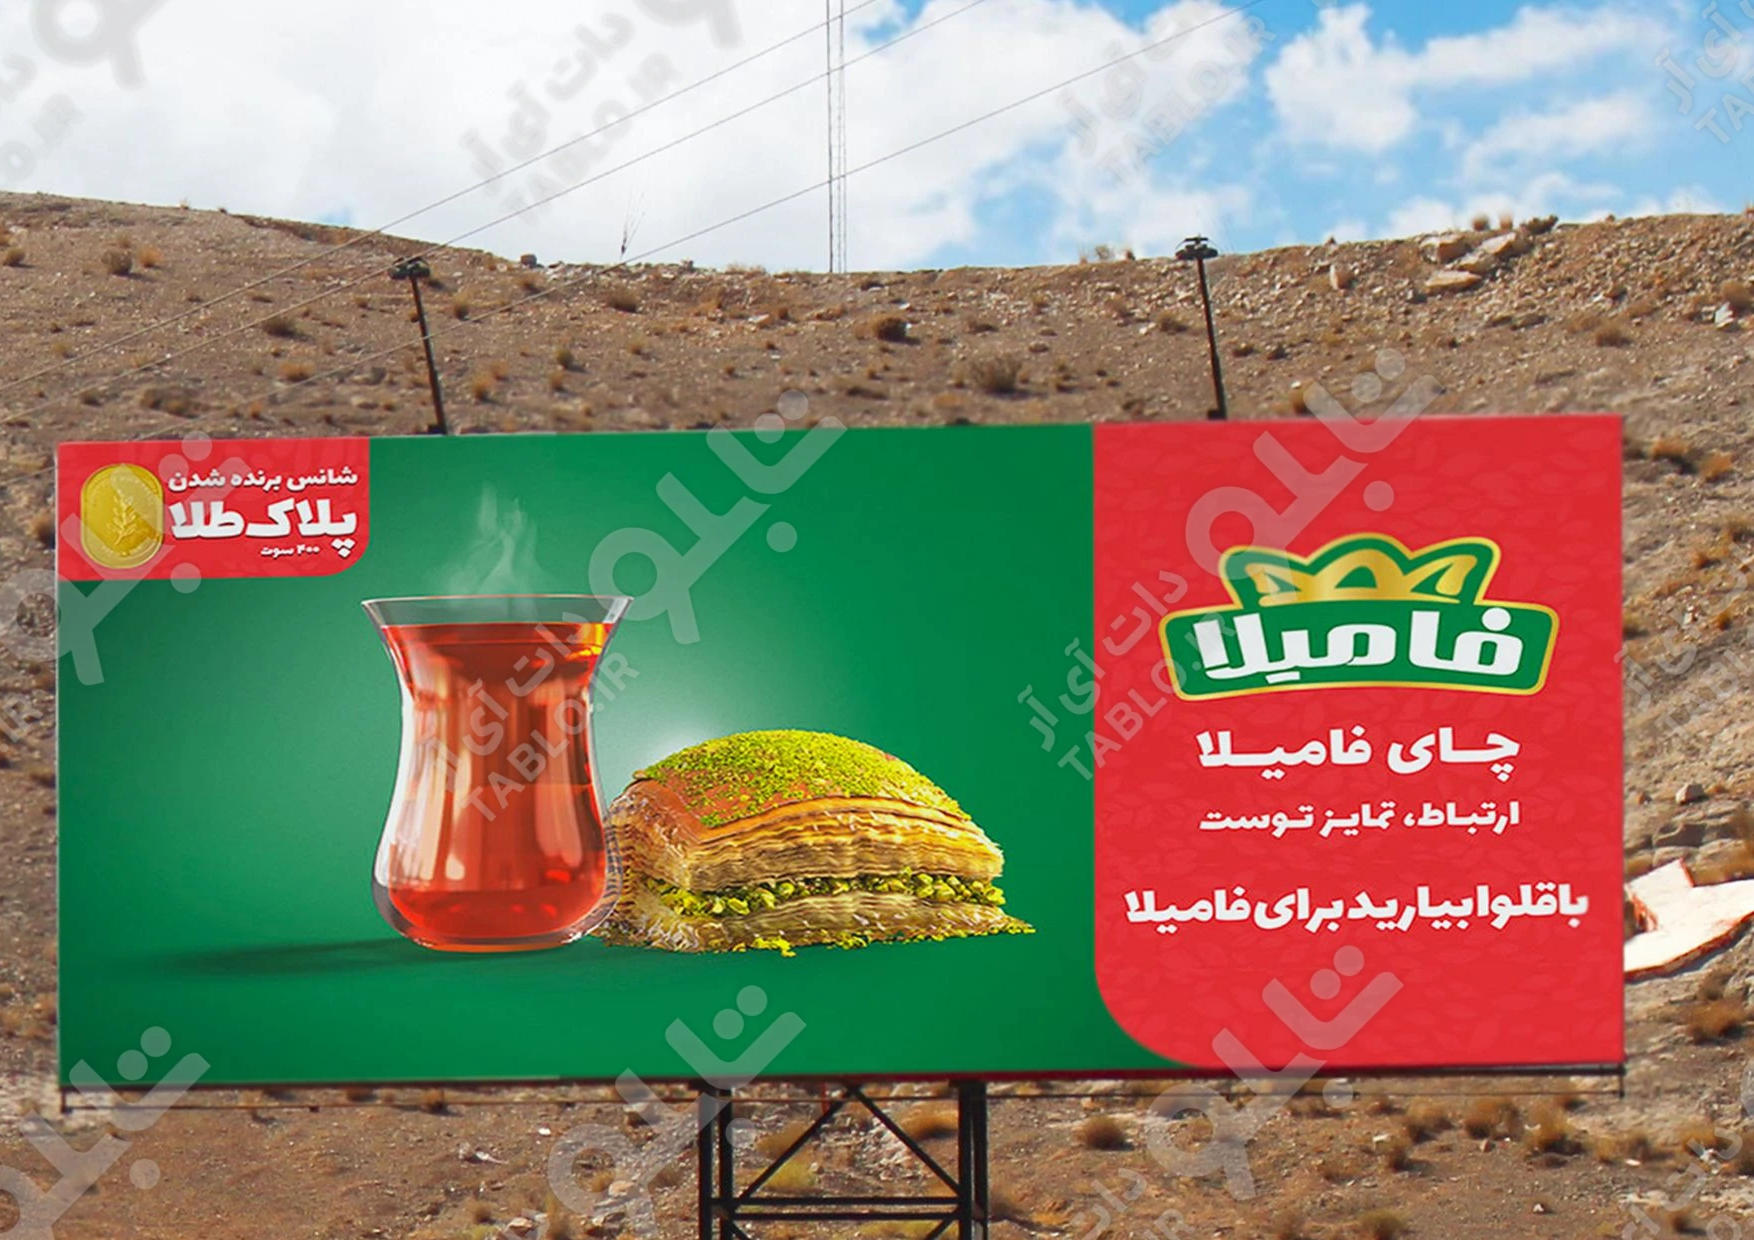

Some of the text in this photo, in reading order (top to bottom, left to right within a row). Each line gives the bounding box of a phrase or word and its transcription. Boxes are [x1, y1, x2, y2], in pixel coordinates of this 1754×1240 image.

[168, 466, 358, 491] شانس برنده شدن
[168, 497, 357, 558] پلاک طلا
[260, 547, 294, 558] سوت
[1193, 607, 1524, 684] فامیلا
[1196, 725, 1520, 782] چای فامیلا
[1199, 805, 1315, 838] توست
[1319, 801, 1396, 838] تمایز
[1124, 882, 1589, 934] باقلوا بیارید برای فامیلا
